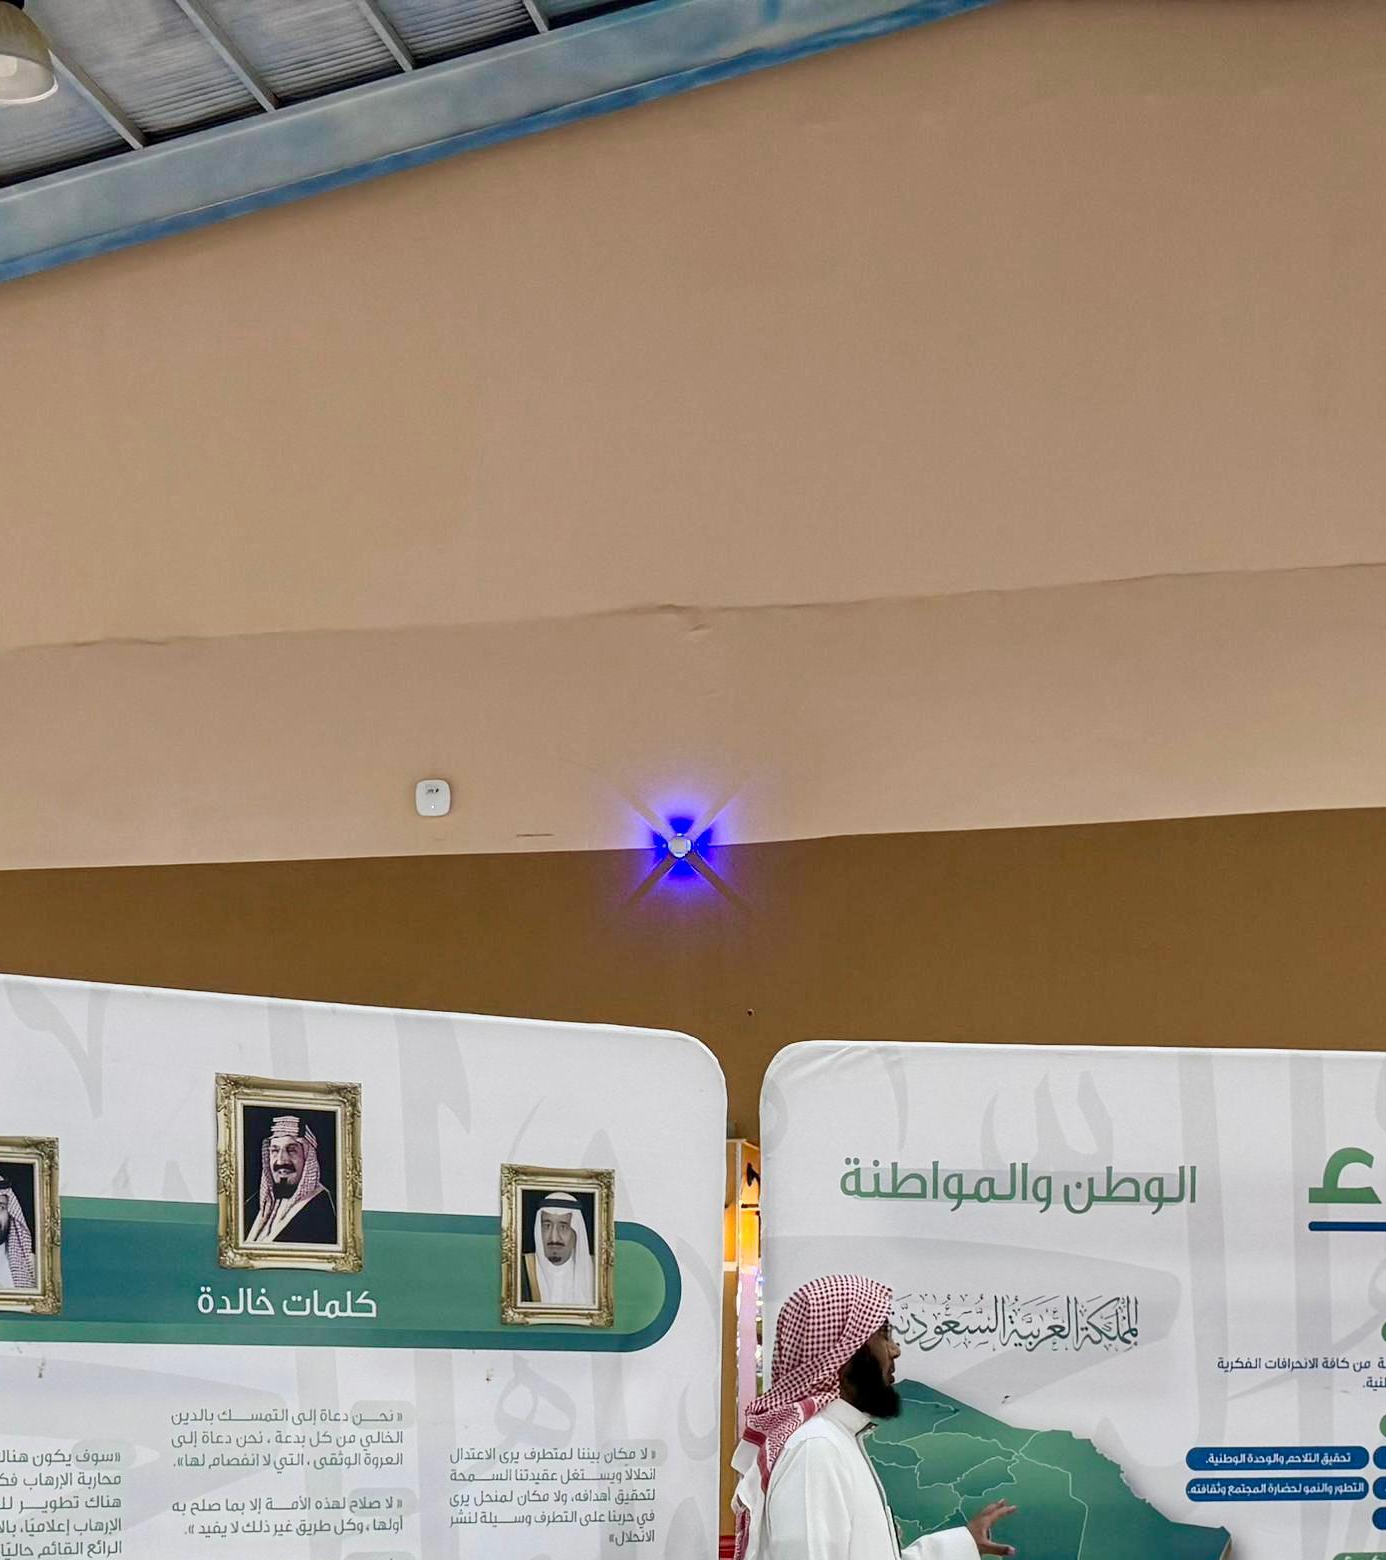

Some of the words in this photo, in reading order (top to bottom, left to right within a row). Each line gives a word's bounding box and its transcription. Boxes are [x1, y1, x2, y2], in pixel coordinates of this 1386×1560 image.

[841, 1158, 1052, 1213] والمواطنة
[1064, 1166, 1196, 1215] الوطن
[197, 1285, 276, 1315] خالدة
[281, 1288, 378, 1320] كلمات
[1218, 1357, 1261, 1372] الفكرية
[1265, 1358, 1318, 1371] الانحرافات
[1322, 1357, 1349, 1369] كافة
[1353, 1361, 1370, 1372] من
